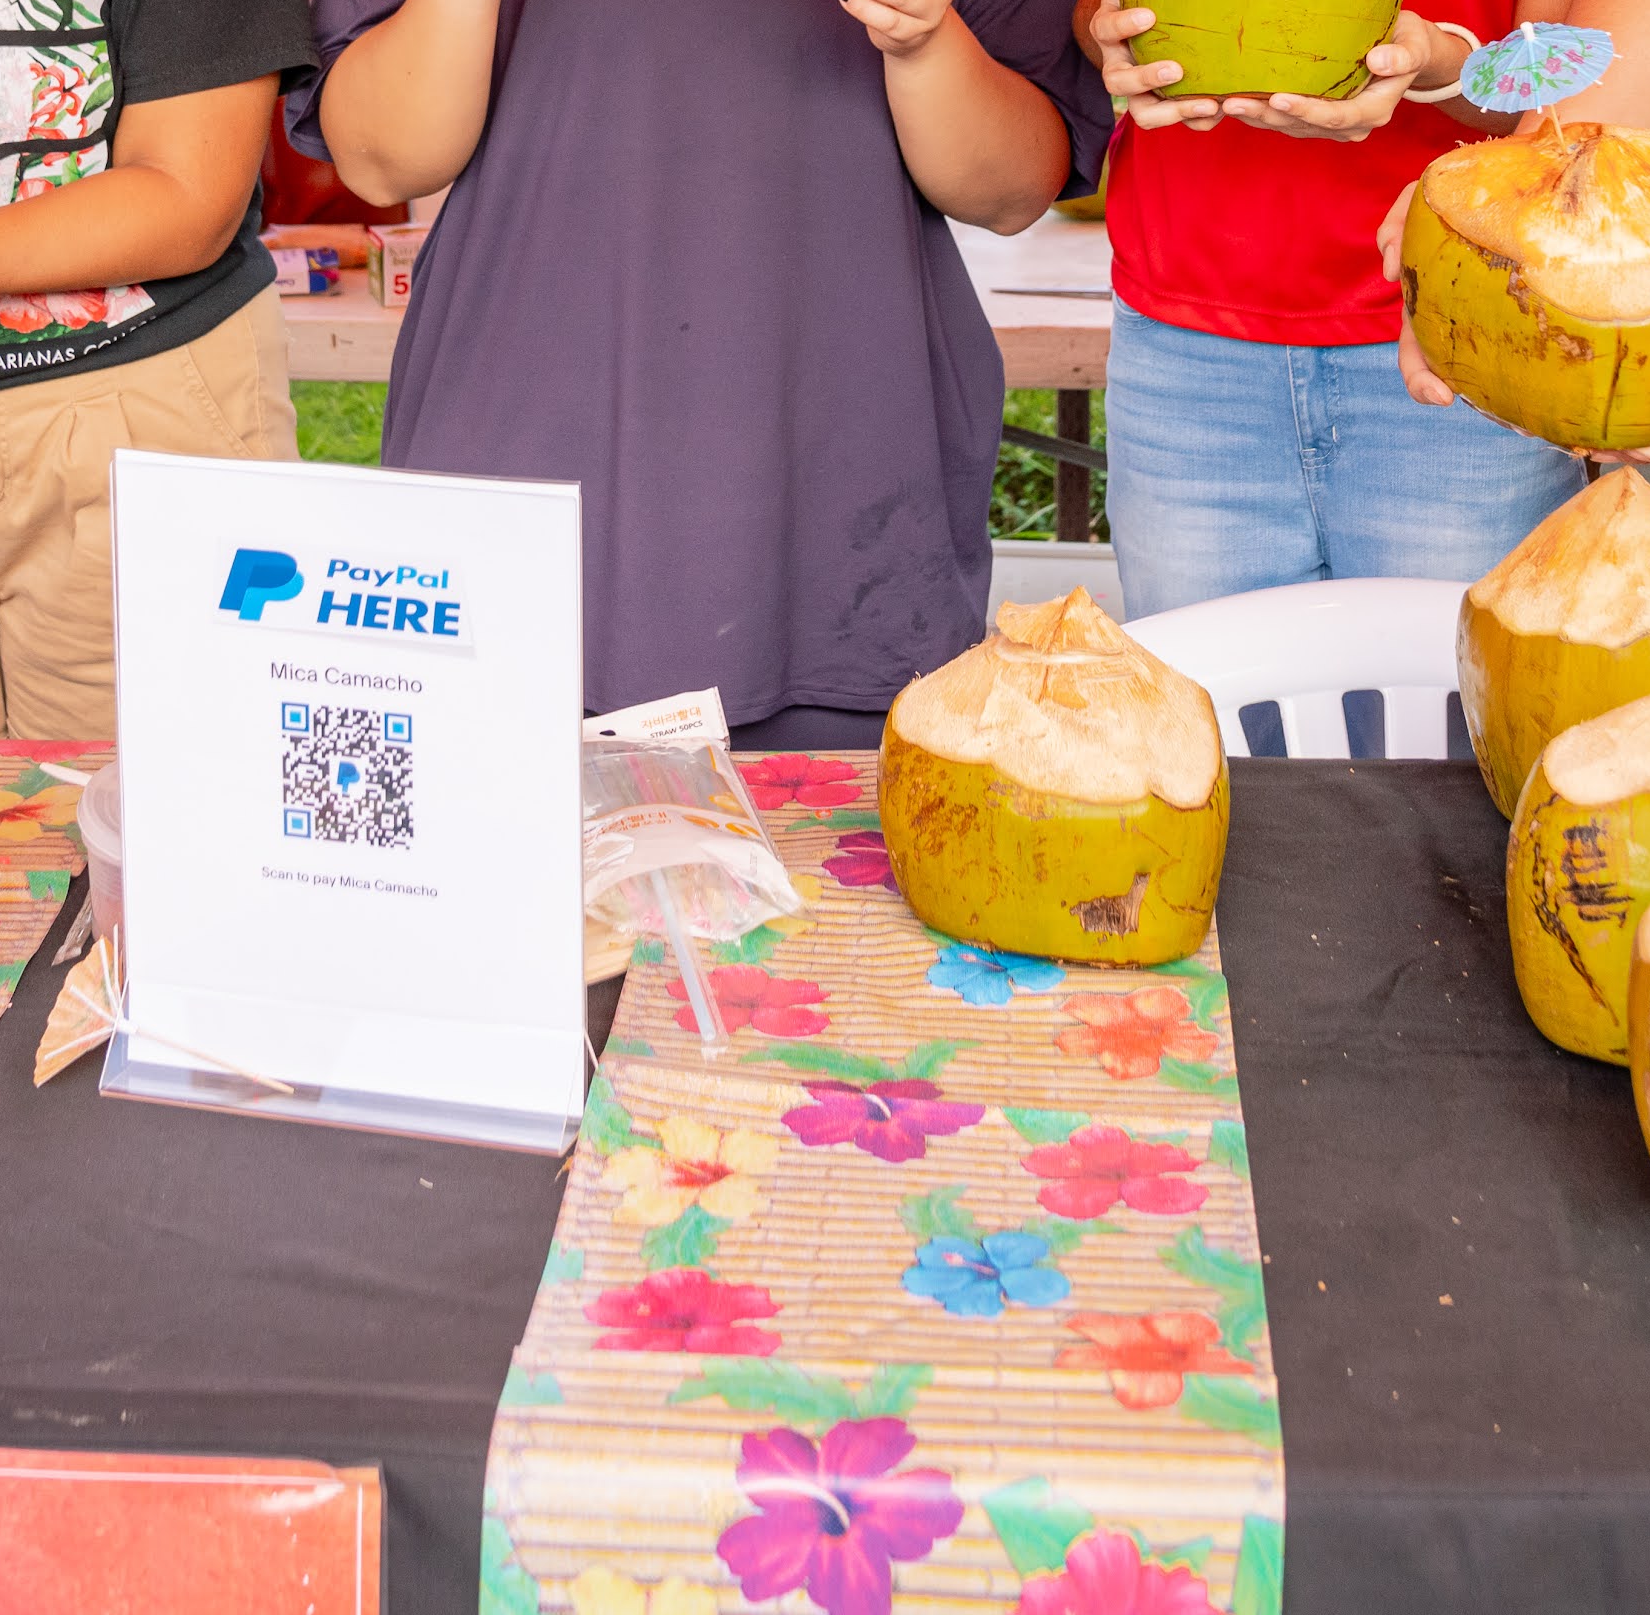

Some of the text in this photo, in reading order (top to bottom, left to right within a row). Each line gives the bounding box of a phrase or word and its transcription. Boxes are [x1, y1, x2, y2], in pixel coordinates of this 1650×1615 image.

[326, 558, 449, 590] PayPal
[316, 590, 461, 637] HERE
[270, 662, 423, 693] Mica Camacho
[641, 706, 702, 729] 자바라빨대
[650, 720, 703, 739] STRAW 50PCS
[261, 866, 439, 898] Scan to pay Mica Camacho
